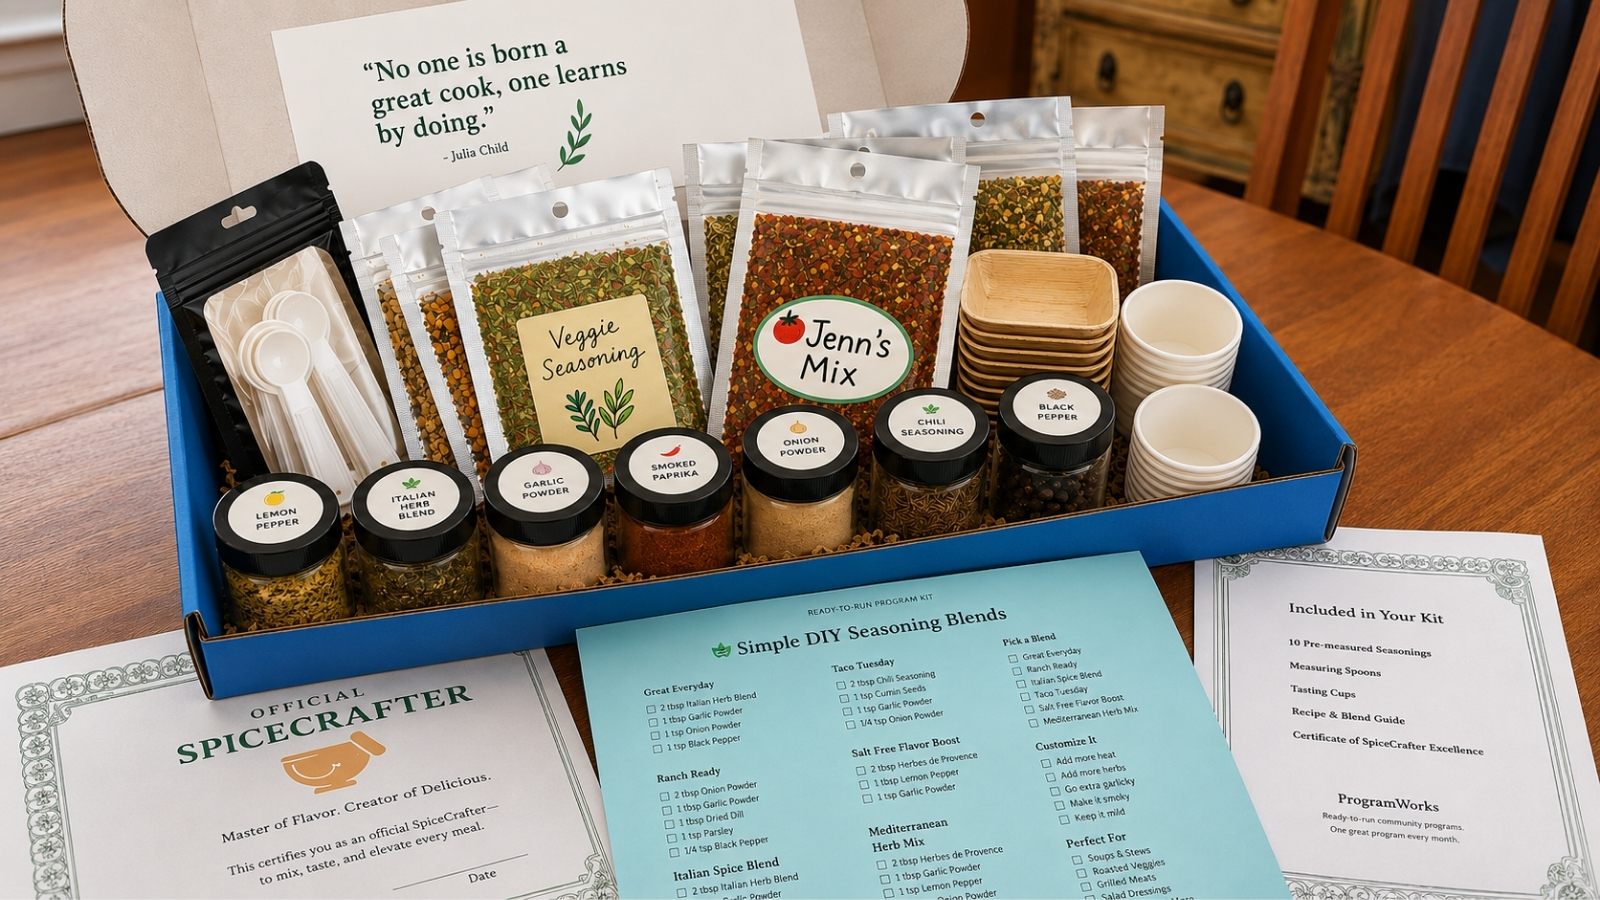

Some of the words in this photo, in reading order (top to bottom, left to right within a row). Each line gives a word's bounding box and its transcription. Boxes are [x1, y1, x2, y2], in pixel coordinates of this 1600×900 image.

[417, 56, 460, 75] one
[465, 47, 486, 68] is
[490, 43, 548, 64] born
[554, 40, 568, 55] a
[371, 88, 434, 120] great
[439, 75, 502, 103] cook,
[508, 73, 551, 92] one
[554, 61, 627, 85] learns
[374, 122, 406, 148] by
[450, 148, 477, 163] Julia
[478, 141, 510, 156] Child
[548, 318, 620, 352] Veggie
[805, 319, 891, 358] Jenn's
[542, 346, 646, 381] Seasoning
[800, 354, 858, 387] Mix
[1038, 403, 1074, 411] BLACK
[917, 418, 946, 426] CHILI
[1037, 413, 1078, 421] PEPPER
[783, 436, 819, 446] ONION
[900, 428, 964, 437] SEASONING
[780, 446, 826, 457] POWDER
[651, 460, 696, 472] SMOKED
[523, 477, 564, 489] GARLIC
[652, 470, 699, 481] PAPRIKA
[391, 490, 436, 503] ITALIAN
[522, 486, 570, 500] POWDER
[256, 508, 297, 520] LEMON
[398, 508, 436, 520] BLEND
[400, 500, 430, 511] HERB
[256, 518, 300, 530] PEPPER
[807, 601, 873, 616] READY-TO-RUN
[874, 596, 918, 607] PROGRAM
[919, 593, 933, 601] KIT
[1289, 602, 1356, 618] Included
[1360, 608, 1376, 620] in
[1378, 609, 1416, 622] Your
[1420, 612, 1444, 624] Kit
[737, 635, 800, 656] Simple
[804, 628, 841, 646] DIY
[848, 618, 942, 640] Seasoning
[944, 607, 1007, 627] Blends
[1002, 637, 1023, 647] Pick
[1030, 632, 1057, 643] Blend
[1289, 638, 1301, 646] 10
[1303, 640, 1374, 653] Pre-measured
[1375, 645, 1432, 659] Seasonings
[830, 664, 855, 673] Taco
[855, 658, 895, 670] Tuesday
[1026, 663, 1052, 673] Ranch
[1052, 660, 1078, 670] Ready
[1290, 661, 1343, 676] Measuring
[1344, 666, 1382, 678] Spoons
[643, 687, 670, 697] Great
[672, 681, 714, 693] Everyday
[1290, 684, 1328, 698] Tasting
[1330, 688, 1356, 700] Cups
[250, 687, 365, 719] OFFICIAL
[660, 704, 666, 712] 2
[666, 702, 685, 711] tbsp
[686, 699, 712, 708] Italian
[712, 695, 733, 704] Herb
[733, 691, 757, 702] Blend
[1292, 707, 1326, 719] Recipe
[1328, 710, 1338, 719] &
[1341, 711, 1371, 722] Blend
[1373, 714, 1406, 725] Guide
[176, 685, 474, 765] SPICECRAFTER
[667, 743, 672, 752] 1
[673, 743, 687, 751] tsp
[688, 738, 711, 749] Black
[711, 735, 741, 746] Pepper
[851, 747, 872, 758] Salt
[873, 746, 896, 755] Free
[898, 741, 930, 752] Flavor
[931, 736, 961, 747] Boost
[1035, 738, 1087, 751] Customize
[1088, 735, 1098, 744] It
[1292, 730, 1347, 744] Certificate
[1348, 736, 1361, 745] of
[1362, 737, 1427, 751] SpiceCrafter
[1428, 743, 1484, 756] Excellence
[870, 765, 877, 774] 2
[877, 764, 897, 772] tbsp
[897, 759, 928, 769] Herbes
[928, 756, 940, 765] de
[940, 752, 978, 764] Provence
[656, 771, 688, 783] Ranch
[690, 766, 721, 779] Ready
[674, 790, 680, 799] 2
[680, 789, 700, 799] tbsp
[700, 785, 726, 796] Onion
[726, 780, 758, 792] Powder
[1064, 784, 1078, 794] Go
[1078, 782, 1101, 792] extra
[1102, 777, 1135, 791] garlicky
[221, 824, 270, 844] Master
[274, 817, 288, 830] of
[291, 808, 340, 826] Flavor.
[344, 794, 399, 813] Creator
[403, 786, 418, 799] of
[420, 774, 492, 795] Delicious.
[676, 805, 682, 813] 1
[682, 803, 702, 812] tbsp
[702, 799, 728, 809] Garlic
[728, 794, 760, 806] Powder
[1338, 793, 1440, 812] ProgramWorks
[868, 819, 948, 837] Mediterranean
[1322, 812, 1376, 824] Ready-to-run
[1377, 818, 1423, 830] community
[1424, 822, 1465, 832] programs.
[1065, 836, 1106, 849] Perfect
[1106, 832, 1126, 843] For
[1329, 825, 1347, 834] One
[1348, 828, 1370, 837] great
[1371, 831, 1406, 840] program
[1406, 834, 1430, 843] every
[1431, 836, 1460, 844] month.
[226, 862, 256, 876] This
[258, 850, 307, 868] certifies
[308, 843, 332, 858] you
[335, 839, 348, 849] as
[351, 835, 366, 845] an
[368, 822, 410, 840] official
[259, 876, 273, 886] to
[276, 868, 304, 882] mix,
[306, 859, 340, 873] taste,
[342, 848, 367, 864] and
[369, 840, 412, 857] elevate
[415, 831, 448, 846] every
[451, 821, 485, 837] meal.
[872, 840, 901, 853] Herb
[902, 837, 925, 848] Mix
[891, 858, 898, 868] 2
[898, 858, 919, 866] tbsp
[919, 853, 951, 863] Herbes
[952, 850, 964, 860] de
[964, 846, 1004, 858] Provence
[1087, 852, 1116, 863] Soups
[1116, 849, 1124, 858] &
[1124, 847, 1152, 858] Stews
[468, 870, 497, 884] Date
[673, 869, 710, 882] Italian
[712, 863, 744, 878] Spice
[746, 856, 780, 871] Blend
[1096, 877, 1128, 889] Grilled
[1128, 874, 1157, 884] Meats
